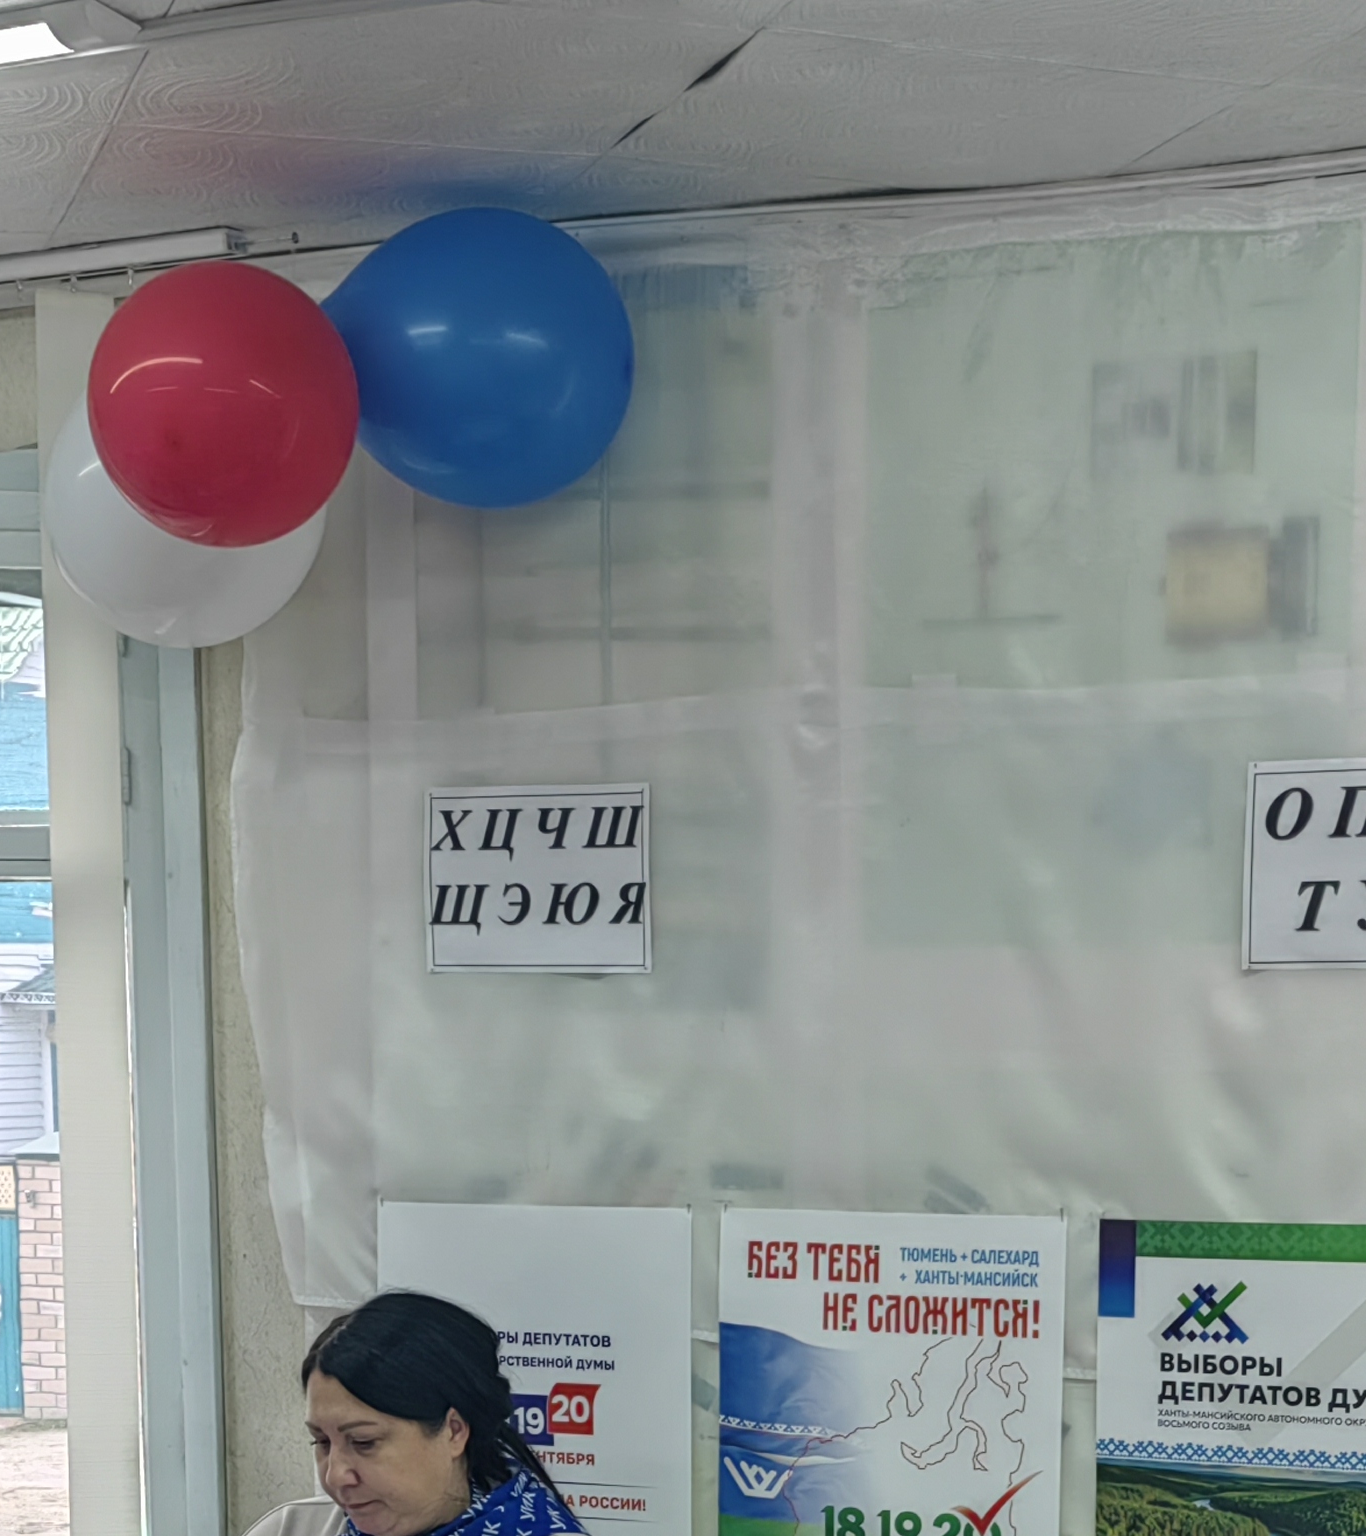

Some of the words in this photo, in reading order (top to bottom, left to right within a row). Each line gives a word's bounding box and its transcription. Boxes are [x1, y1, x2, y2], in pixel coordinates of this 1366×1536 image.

[747, 1240, 799, 1280] БЕЗ
[806, 1242, 881, 1284] ТЕБЯ
[899, 1246, 958, 1264] ТЮМЕНЬ
[970, 1248, 1040, 1268] САЛЕХАРД
[822, 1291, 858, 1332] НЕ
[867, 1294, 1040, 1338] СЛОЖИТСЯ!
[522, 1332, 612, 1348] ДЕПУТАТОВ
[498, 1355, 573, 1369] РСТВЕННОЙ
[575, 1358, 615, 1371] ДУМЫ
[1159, 1352, 1283, 1377] ВЫБОРЫ
[1157, 1380, 1322, 1408] ДЕПУТАТОВ
[513, 1406, 545, 1436] 19
[550, 1394, 591, 1424] 20
[1157, 1409, 1266, 1423] ХАНТЫ-МАНСИЙСКОГО
[1267, 1413, 1343, 1427] АВТОНОМНОГО
[1157, 1419, 1210, 1430] ВОСЬМОГО
[1211, 1421, 1252, 1432] СОЗЫВА
[535, 1451, 596, 1466] НТЯБРЯ
[579, 1494, 647, 1512] РОССИИ!
